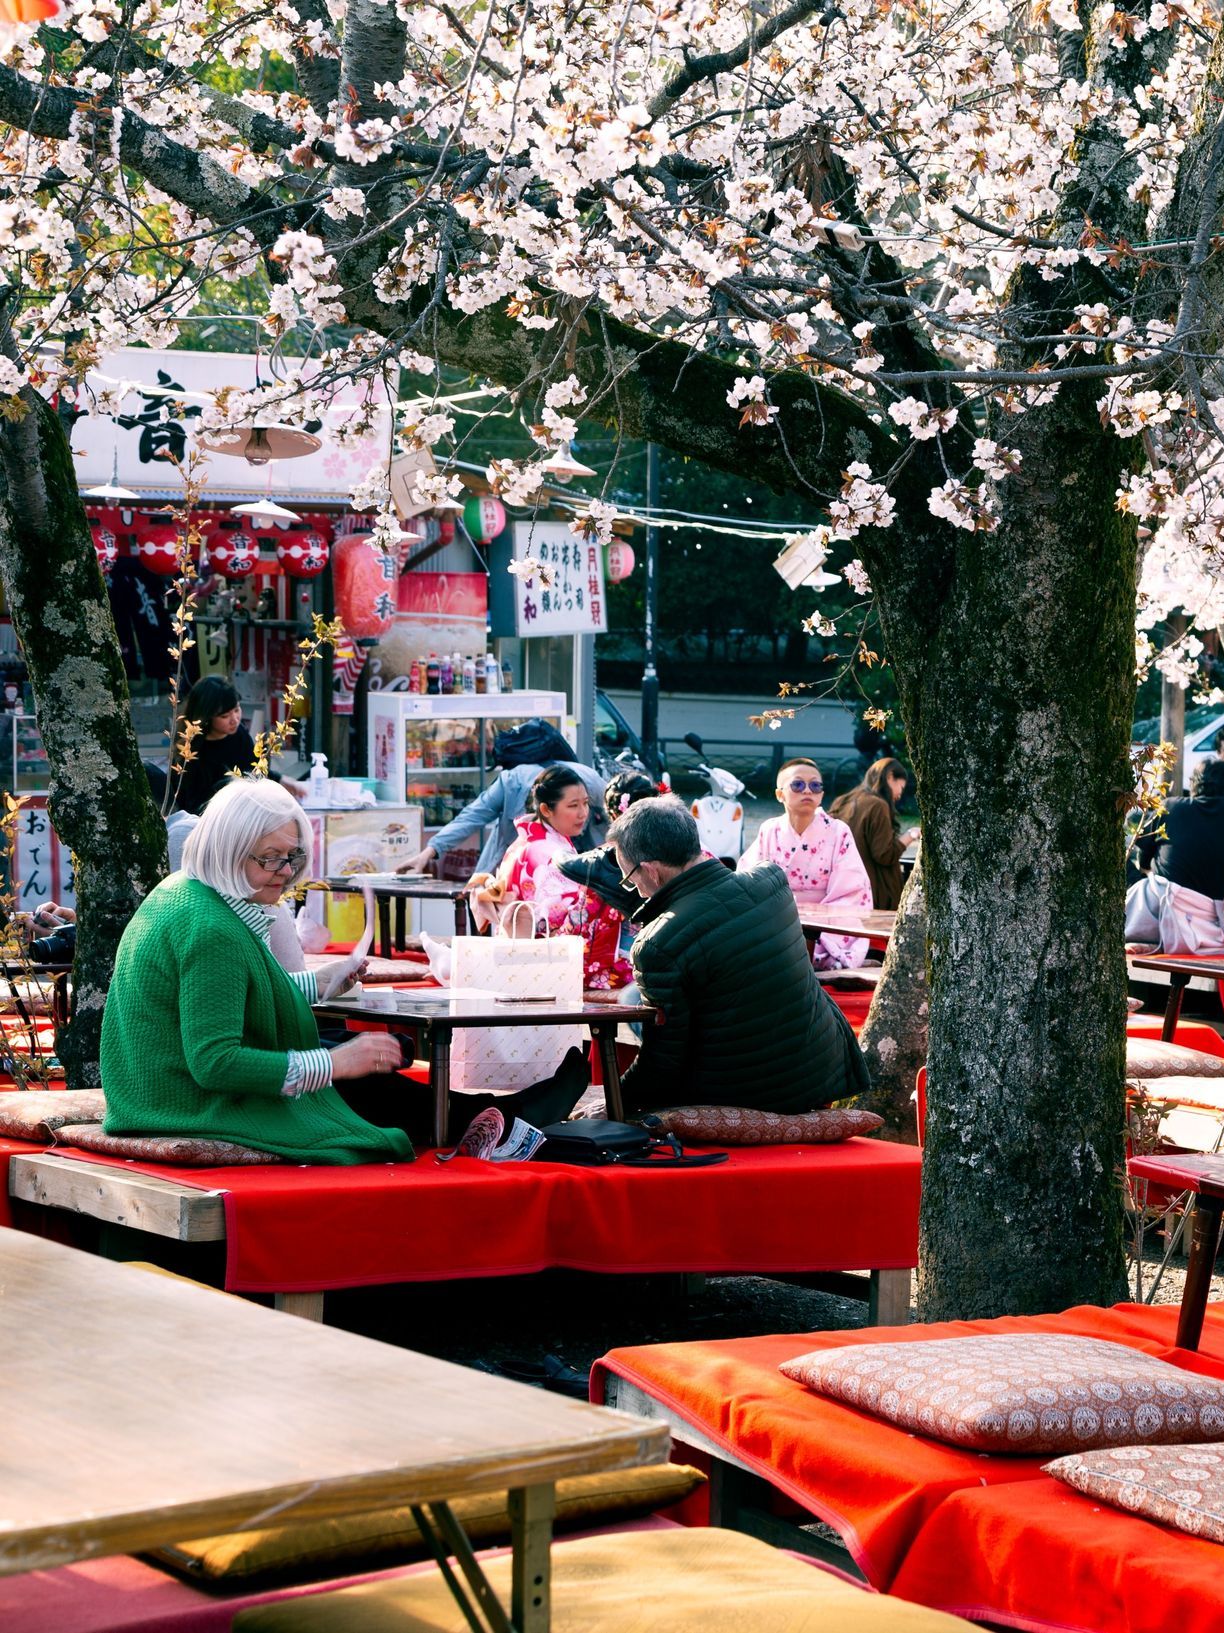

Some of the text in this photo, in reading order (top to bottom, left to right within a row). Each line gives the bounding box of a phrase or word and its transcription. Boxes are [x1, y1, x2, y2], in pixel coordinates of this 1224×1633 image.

[228, 532, 252, 572] 音和
[302, 533, 326, 570] 音和
[23, 811, 47, 898] おでん
